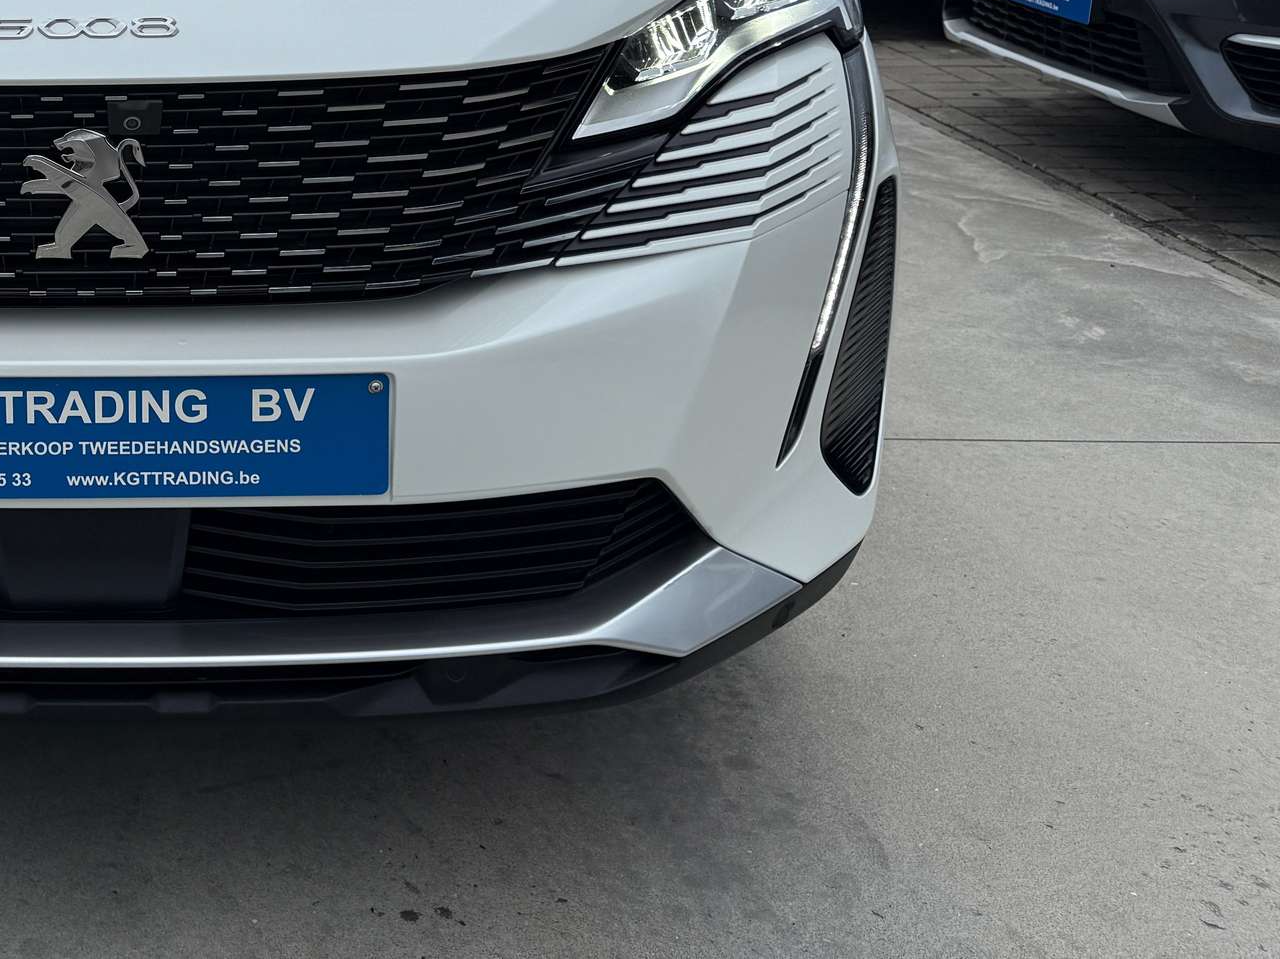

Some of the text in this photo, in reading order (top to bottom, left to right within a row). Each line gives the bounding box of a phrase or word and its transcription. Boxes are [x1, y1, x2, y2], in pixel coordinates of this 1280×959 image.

[251, 388, 316, 423] BV
[79, 439, 302, 455] TWEEDEHANDSWAGENS
[12, 472, 32, 487] 33
[67, 470, 261, 486] www.KGTTRADING.be
